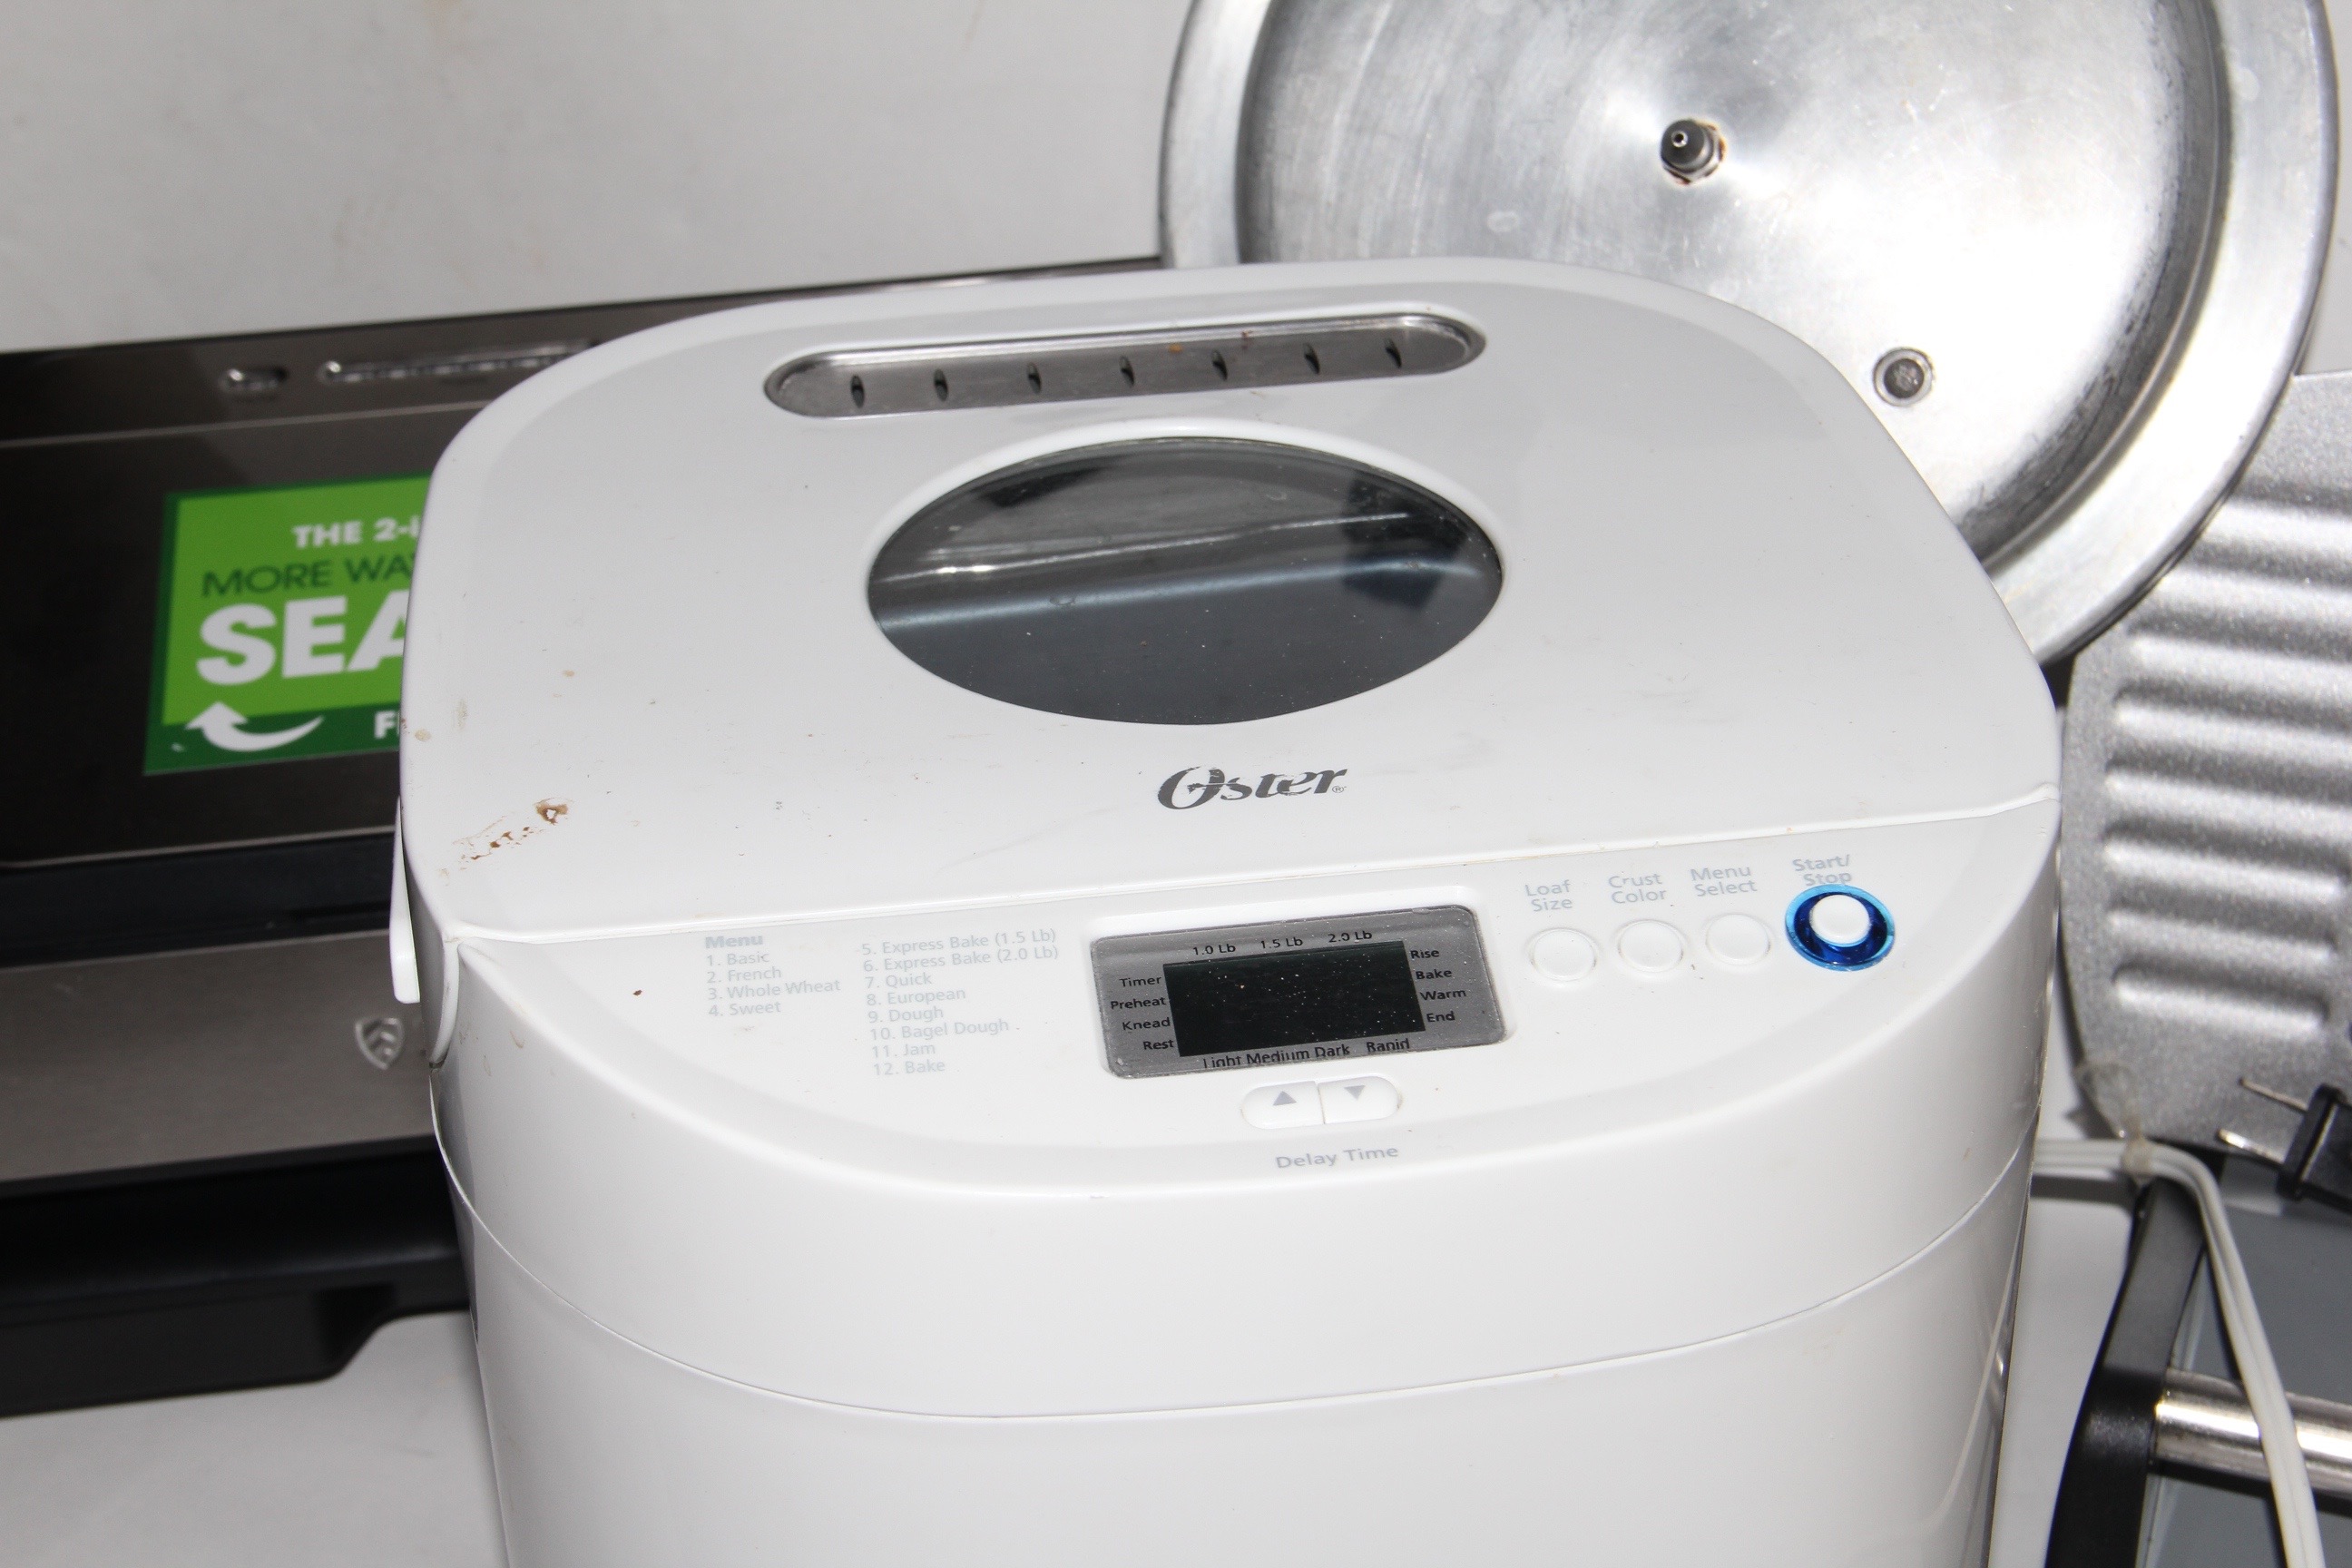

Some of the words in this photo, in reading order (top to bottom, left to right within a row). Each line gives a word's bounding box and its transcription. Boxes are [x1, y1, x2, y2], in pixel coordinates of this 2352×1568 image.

[291, 520, 361, 549] THE
[201, 559, 332, 597] MORE
[344, 553, 416, 583] WA
[1792, 854, 1850, 872] Start/
[1609, 872, 1662, 889] Crust
[1690, 864, 1752, 882] Menu
[1803, 870, 1853, 887] Stop
[1525, 879, 1571, 897] Loaf
[1611, 887, 1667, 905] Color
[1694, 879, 1758, 897] Select
[1530, 897, 1573, 912] Size
[705, 934, 763, 948] Menu
[861, 943, 877, 956] 5.
[882, 940, 944, 956] Express
[950, 934, 989, 948] Bake
[995, 930, 1025, 947] (1.5
[1032, 928, 1057, 944] Lb)
[1260, 939, 1280, 949] 1.5
[1286, 937, 1303, 946] Lb
[1328, 933, 1350, 943] 2.0
[1355, 931, 1372, 941] Lb
[706, 955, 721, 966] 1.
[726, 950, 769, 965] Basic
[1193, 946, 1214, 956] 1.0
[1219, 944, 1236, 953] Lb
[1410, 947, 1439, 959] Rise
[863, 959, 879, 973] 6.
[884, 955, 946, 974] Express
[952, 950, 991, 965] Bake
[997, 948, 1028, 965] (2.0
[1034, 946, 1059, 961] Lb)
[707, 971, 722, 984] 2.
[728, 966, 781, 982] French
[865, 975, 880, 989] 7.
[886, 973, 932, 988] Quick
[1120, 975, 1161, 988] Timer
[1416, 968, 1452, 980] Bake
[708, 987, 723, 1000] 3.
[728, 983, 781, 999] Whole
[785, 978, 840, 995] Wheat
[1419, 988, 1466, 1001] Warm
[867, 993, 882, 1006] 8.
[887, 989, 965, 1004] European
[1110, 995, 1167, 1010] Preheat
[708, 1004, 723, 1017] 4.
[729, 1001, 781, 1015] Sweet
[868, 1011, 884, 1024] 9.
[888, 1006, 944, 1023] Dough
[1426, 1011, 1455, 1023] End
[869, 1028, 897, 1041] 10.
[901, 1023, 947, 1041] Bagel
[954, 1019, 1009, 1036] Dough
[1122, 1017, 1171, 1031] Knead
[872, 1045, 897, 1058] 11.
[903, 1042, 936, 1056] Jam
[1142, 1038, 1174, 1051] Rest
[1247, 1049, 1310, 1064] Medium
[1315, 1044, 1350, 1057] Dark
[874, 1062, 900, 1075] 12.
[905, 1059, 946, 1073] Bake
[1276, 1150, 1337, 1170] Delay
[1343, 1145, 1398, 1162] Time
